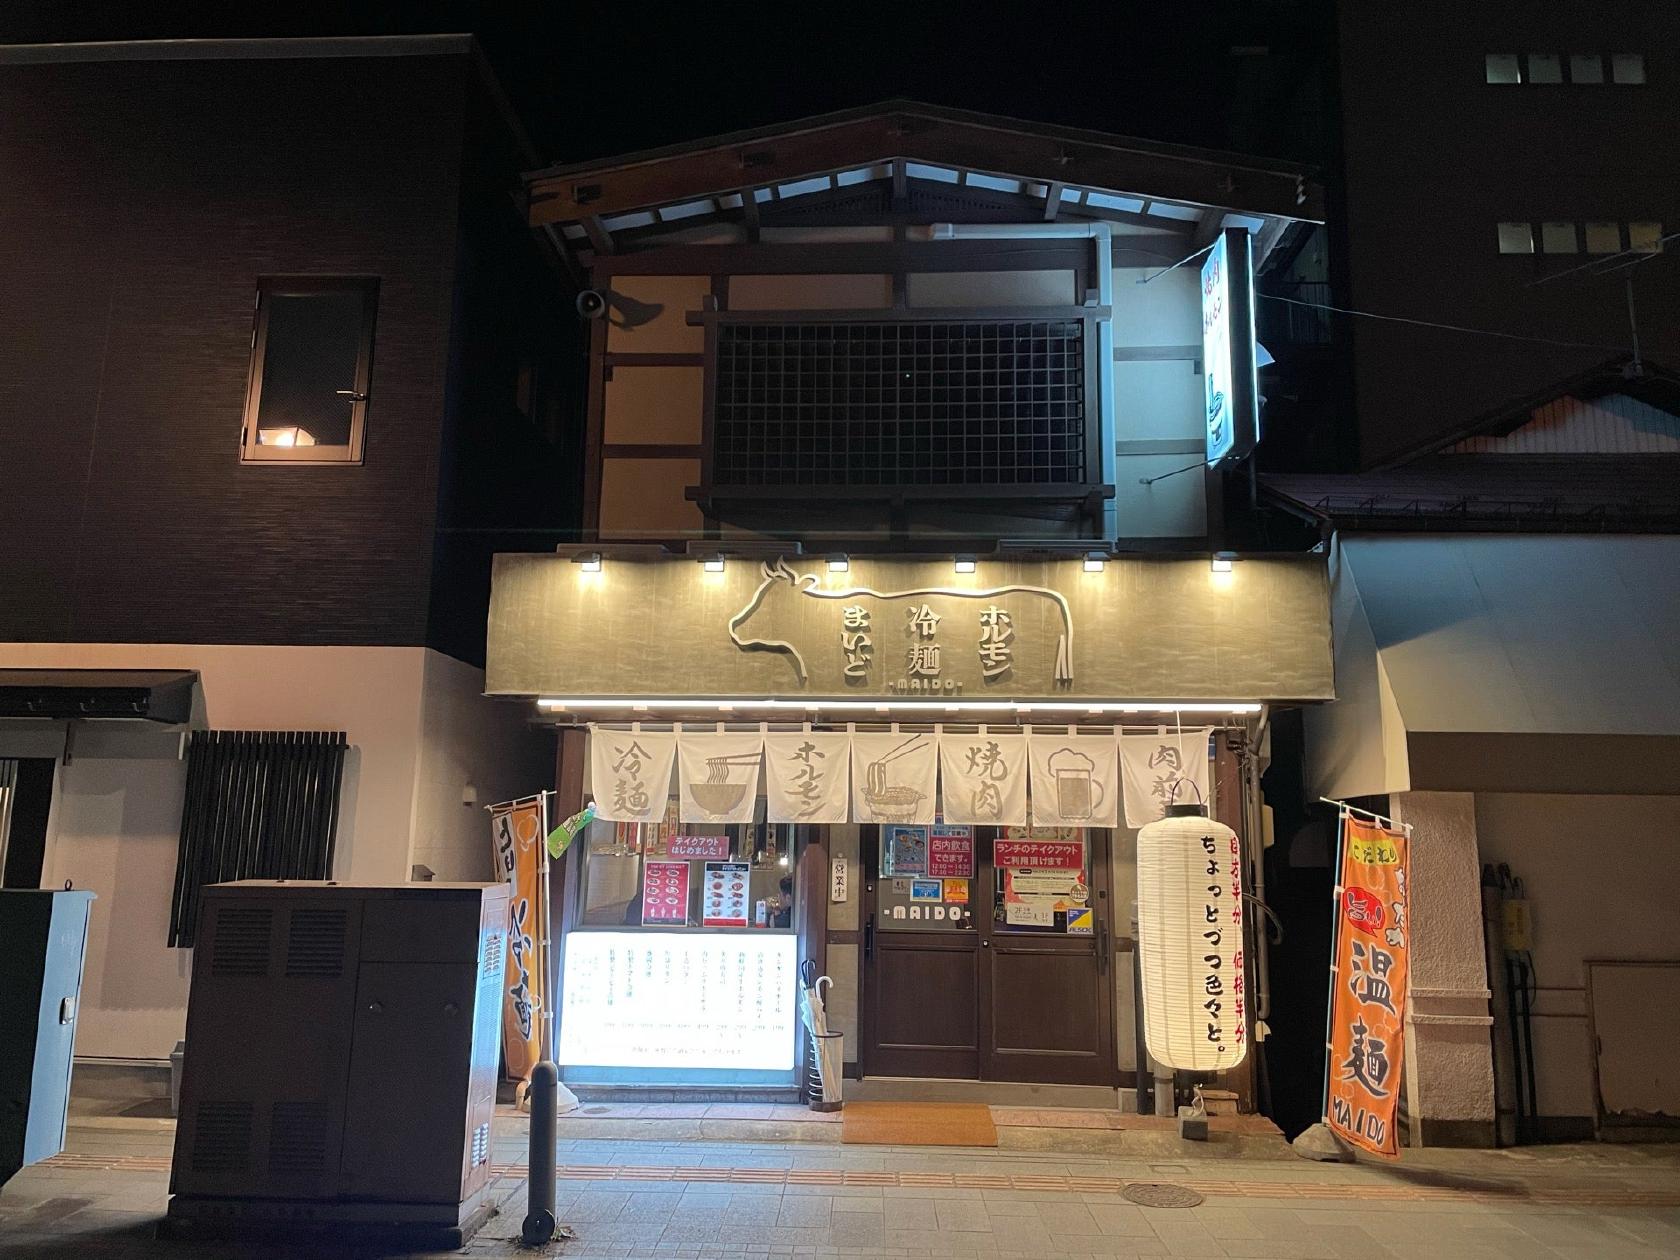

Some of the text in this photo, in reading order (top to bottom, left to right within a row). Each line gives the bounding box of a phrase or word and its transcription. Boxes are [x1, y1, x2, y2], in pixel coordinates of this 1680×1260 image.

[840, 604, 873, 677] まいど
[907, 603, 942, 676] 冷麺
[978, 604, 1013, 677] ホルモン
[613, 740, 653, 817] 冷麺
[784, 740, 826, 819] ホルモン
[965, 740, 1008, 819] 焼肉
[675, 837, 719, 846] テイクアウト
[932, 839, 970, 851] 店内飲食
[996, 843, 1078, 855] ランチのテイクアウト
[1353, 844, 1397, 864] こだわり
[893, 905, 961, 921] MAIDO
[1200, 836, 1226, 1052] ちょっとづつ色々と。
[1342, 940, 1396, 1098] 温麺
[1332, 1096, 1385, 1146] MAIDO
